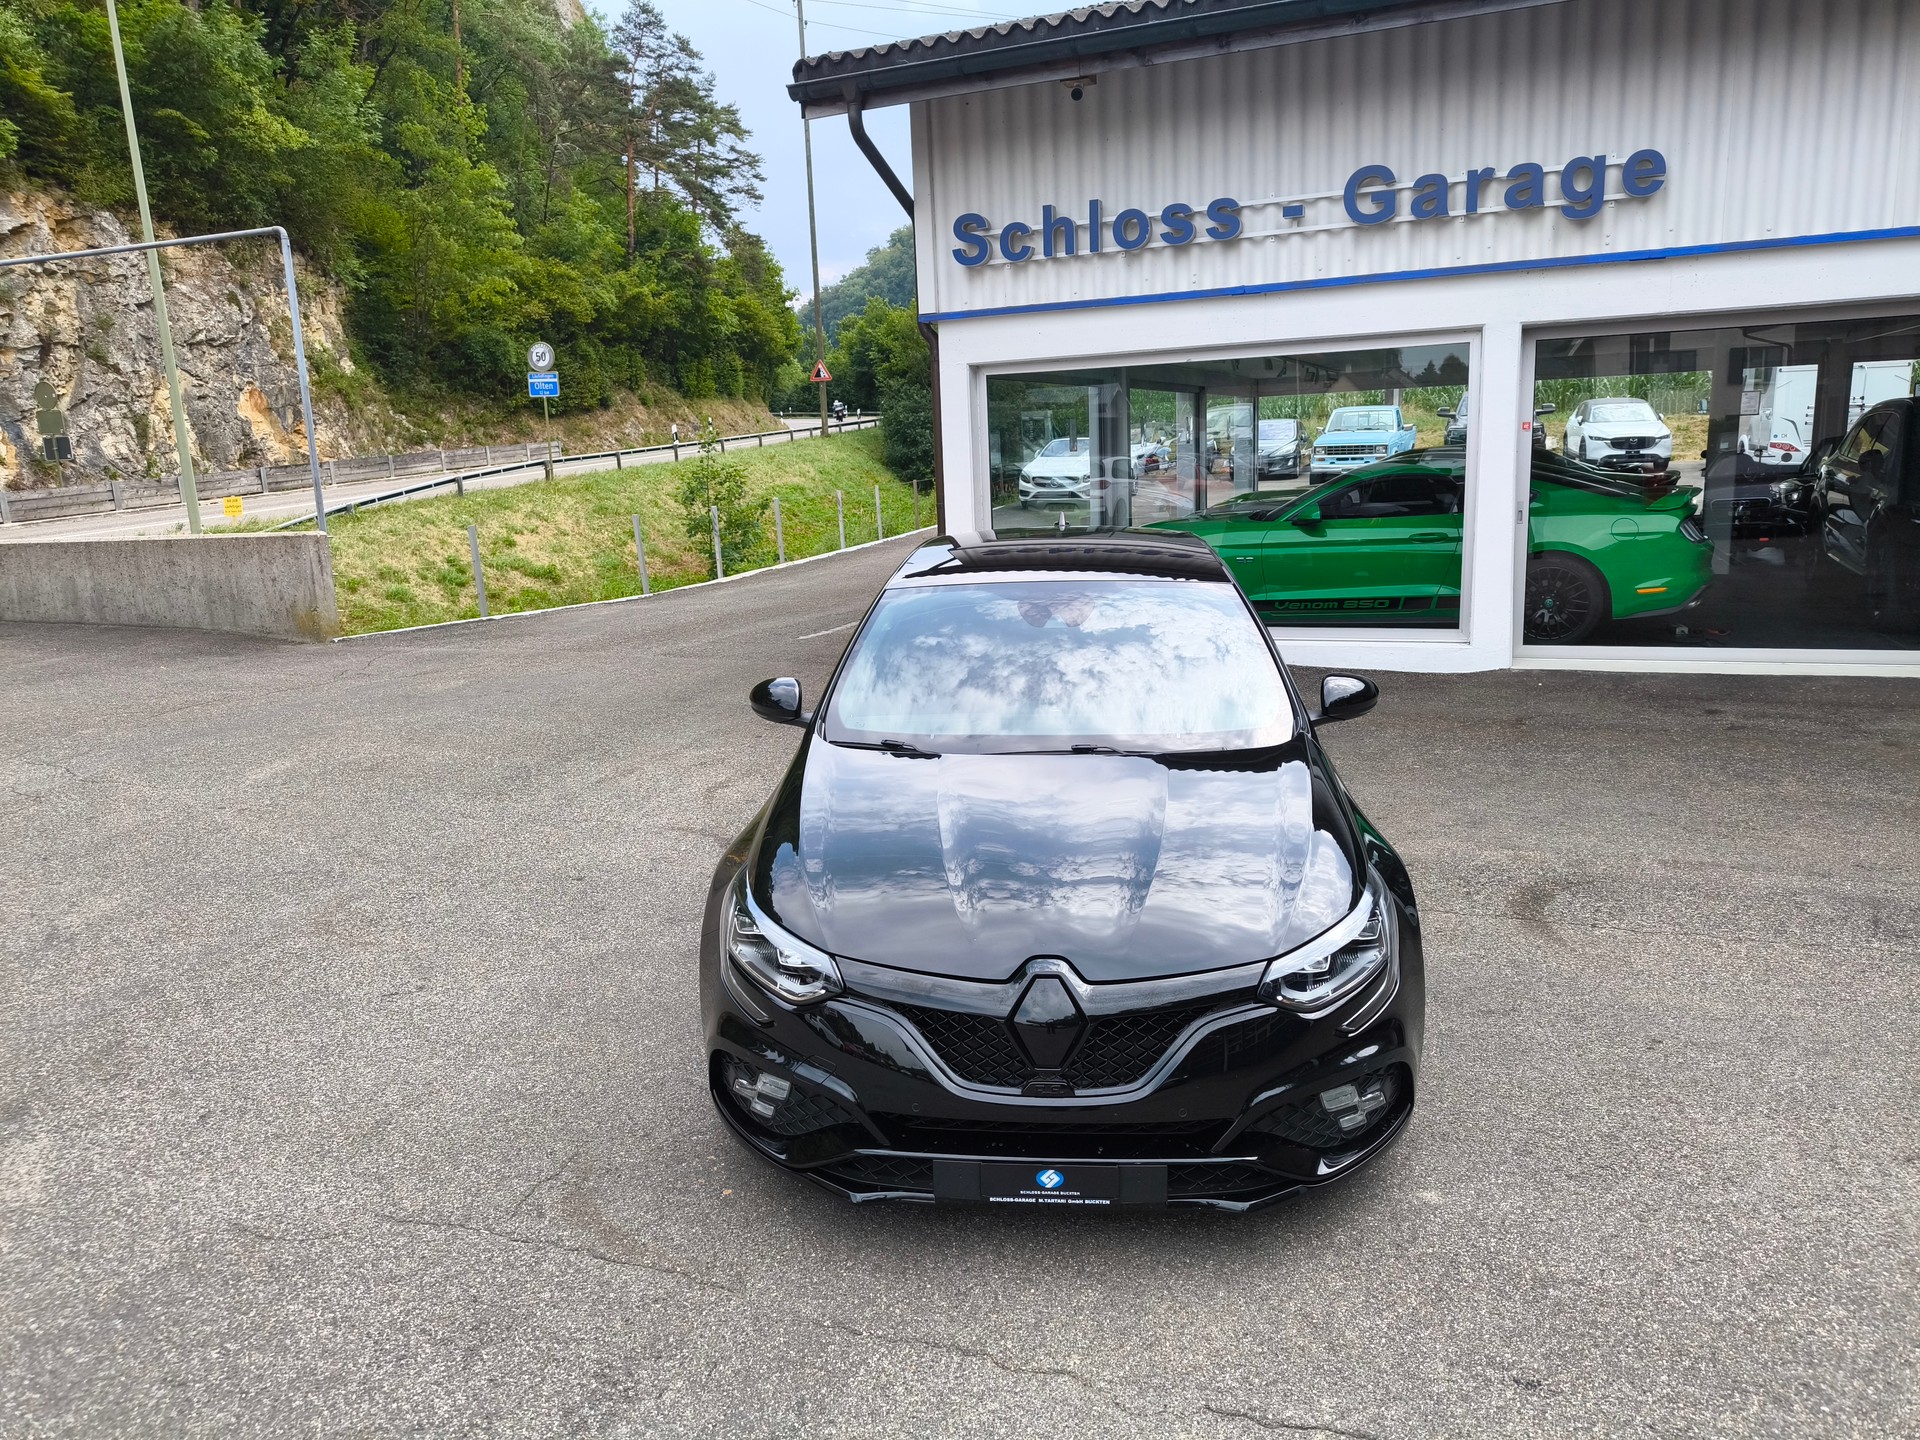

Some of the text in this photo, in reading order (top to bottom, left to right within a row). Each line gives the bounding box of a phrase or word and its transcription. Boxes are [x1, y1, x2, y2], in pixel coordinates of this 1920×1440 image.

[952, 198, 1243, 268] Schloss
[1342, 148, 1668, 226] Garage
[536, 351, 546, 362] 50
[1274, 599, 1390, 610] Venom 850
